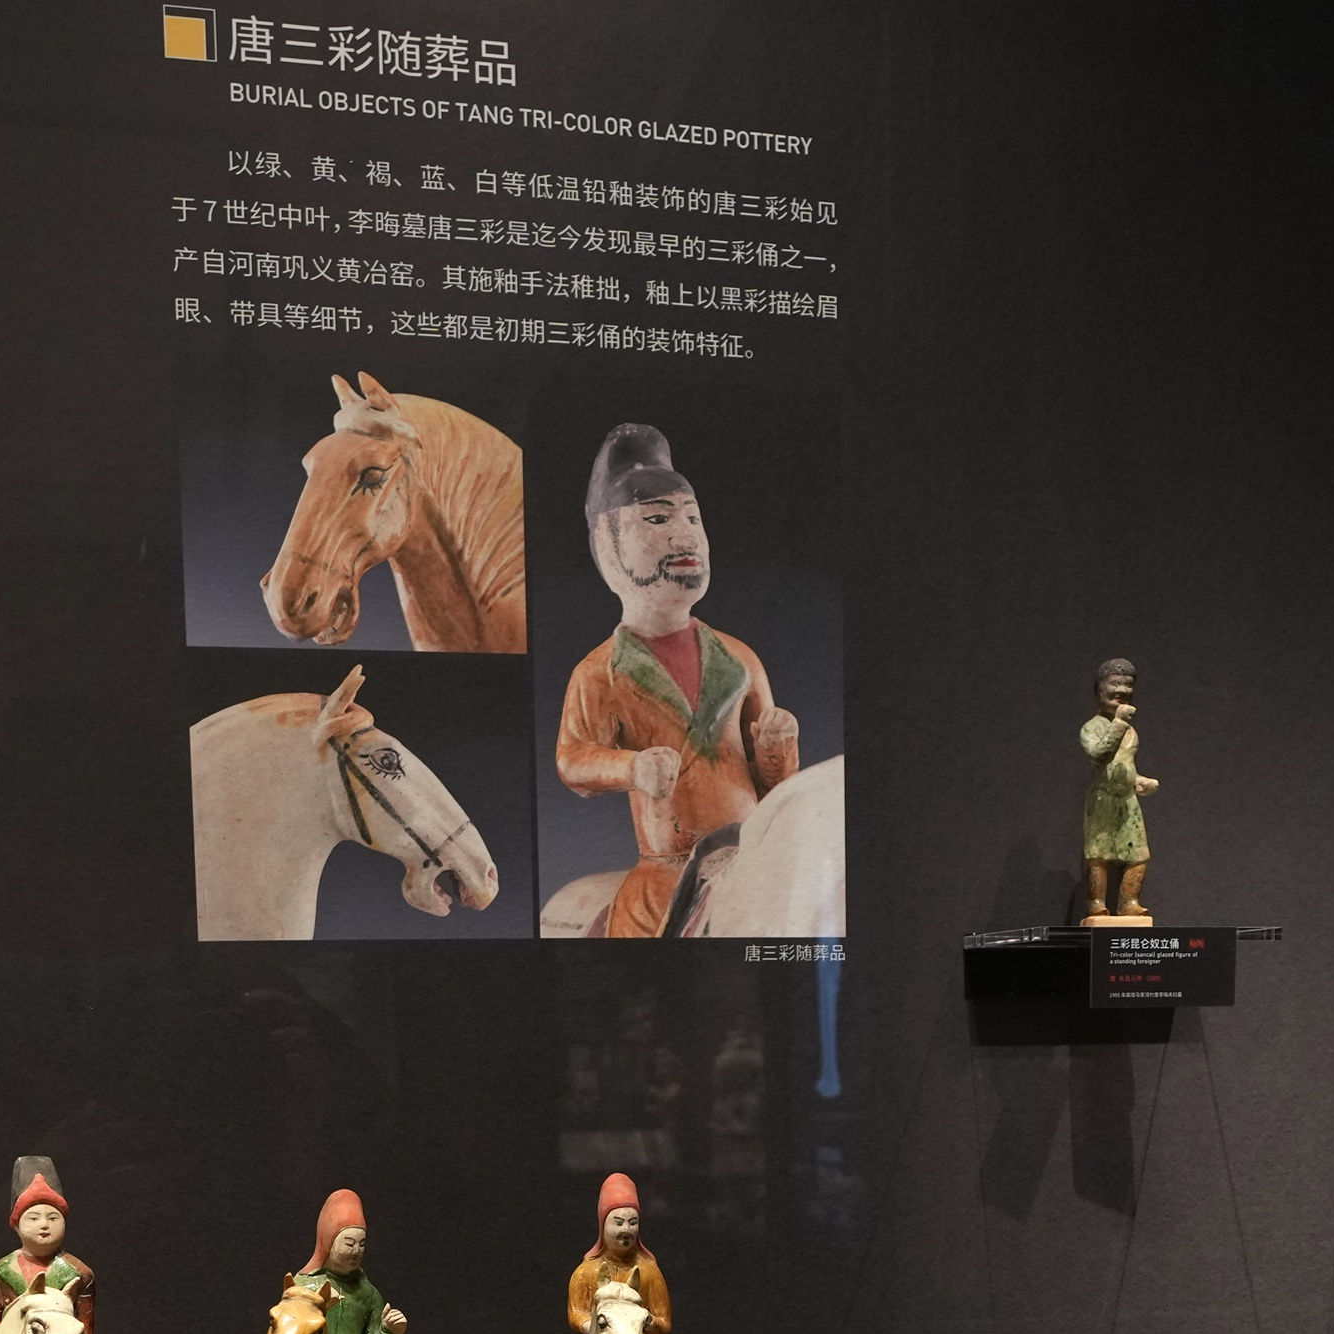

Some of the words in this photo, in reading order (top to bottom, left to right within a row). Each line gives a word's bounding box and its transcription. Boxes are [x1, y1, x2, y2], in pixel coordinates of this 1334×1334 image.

[229, 15, 517, 87] 唐三彩随葬品
[229, 82, 313, 109] BURIAL
[318, 90, 416, 118] OBJECTS
[422, 99, 450, 120] OF
[454, 102, 514, 125] TANG
[519, 107, 632, 137] TRI-COLOR
[638, 120, 718, 146] GLAZED
[723, 128, 813, 155] POTTERY
[228, 150, 838, 226] 以绿、黄、褐、蓝、白等低温铅釉装饰的唐三彩始见
[744, 944, 846, 962] 唐三彩随葬品
[1110, 938, 1180, 949] 三彩昆仑奴立俑
[1175, 951, 1191, 959] figure
